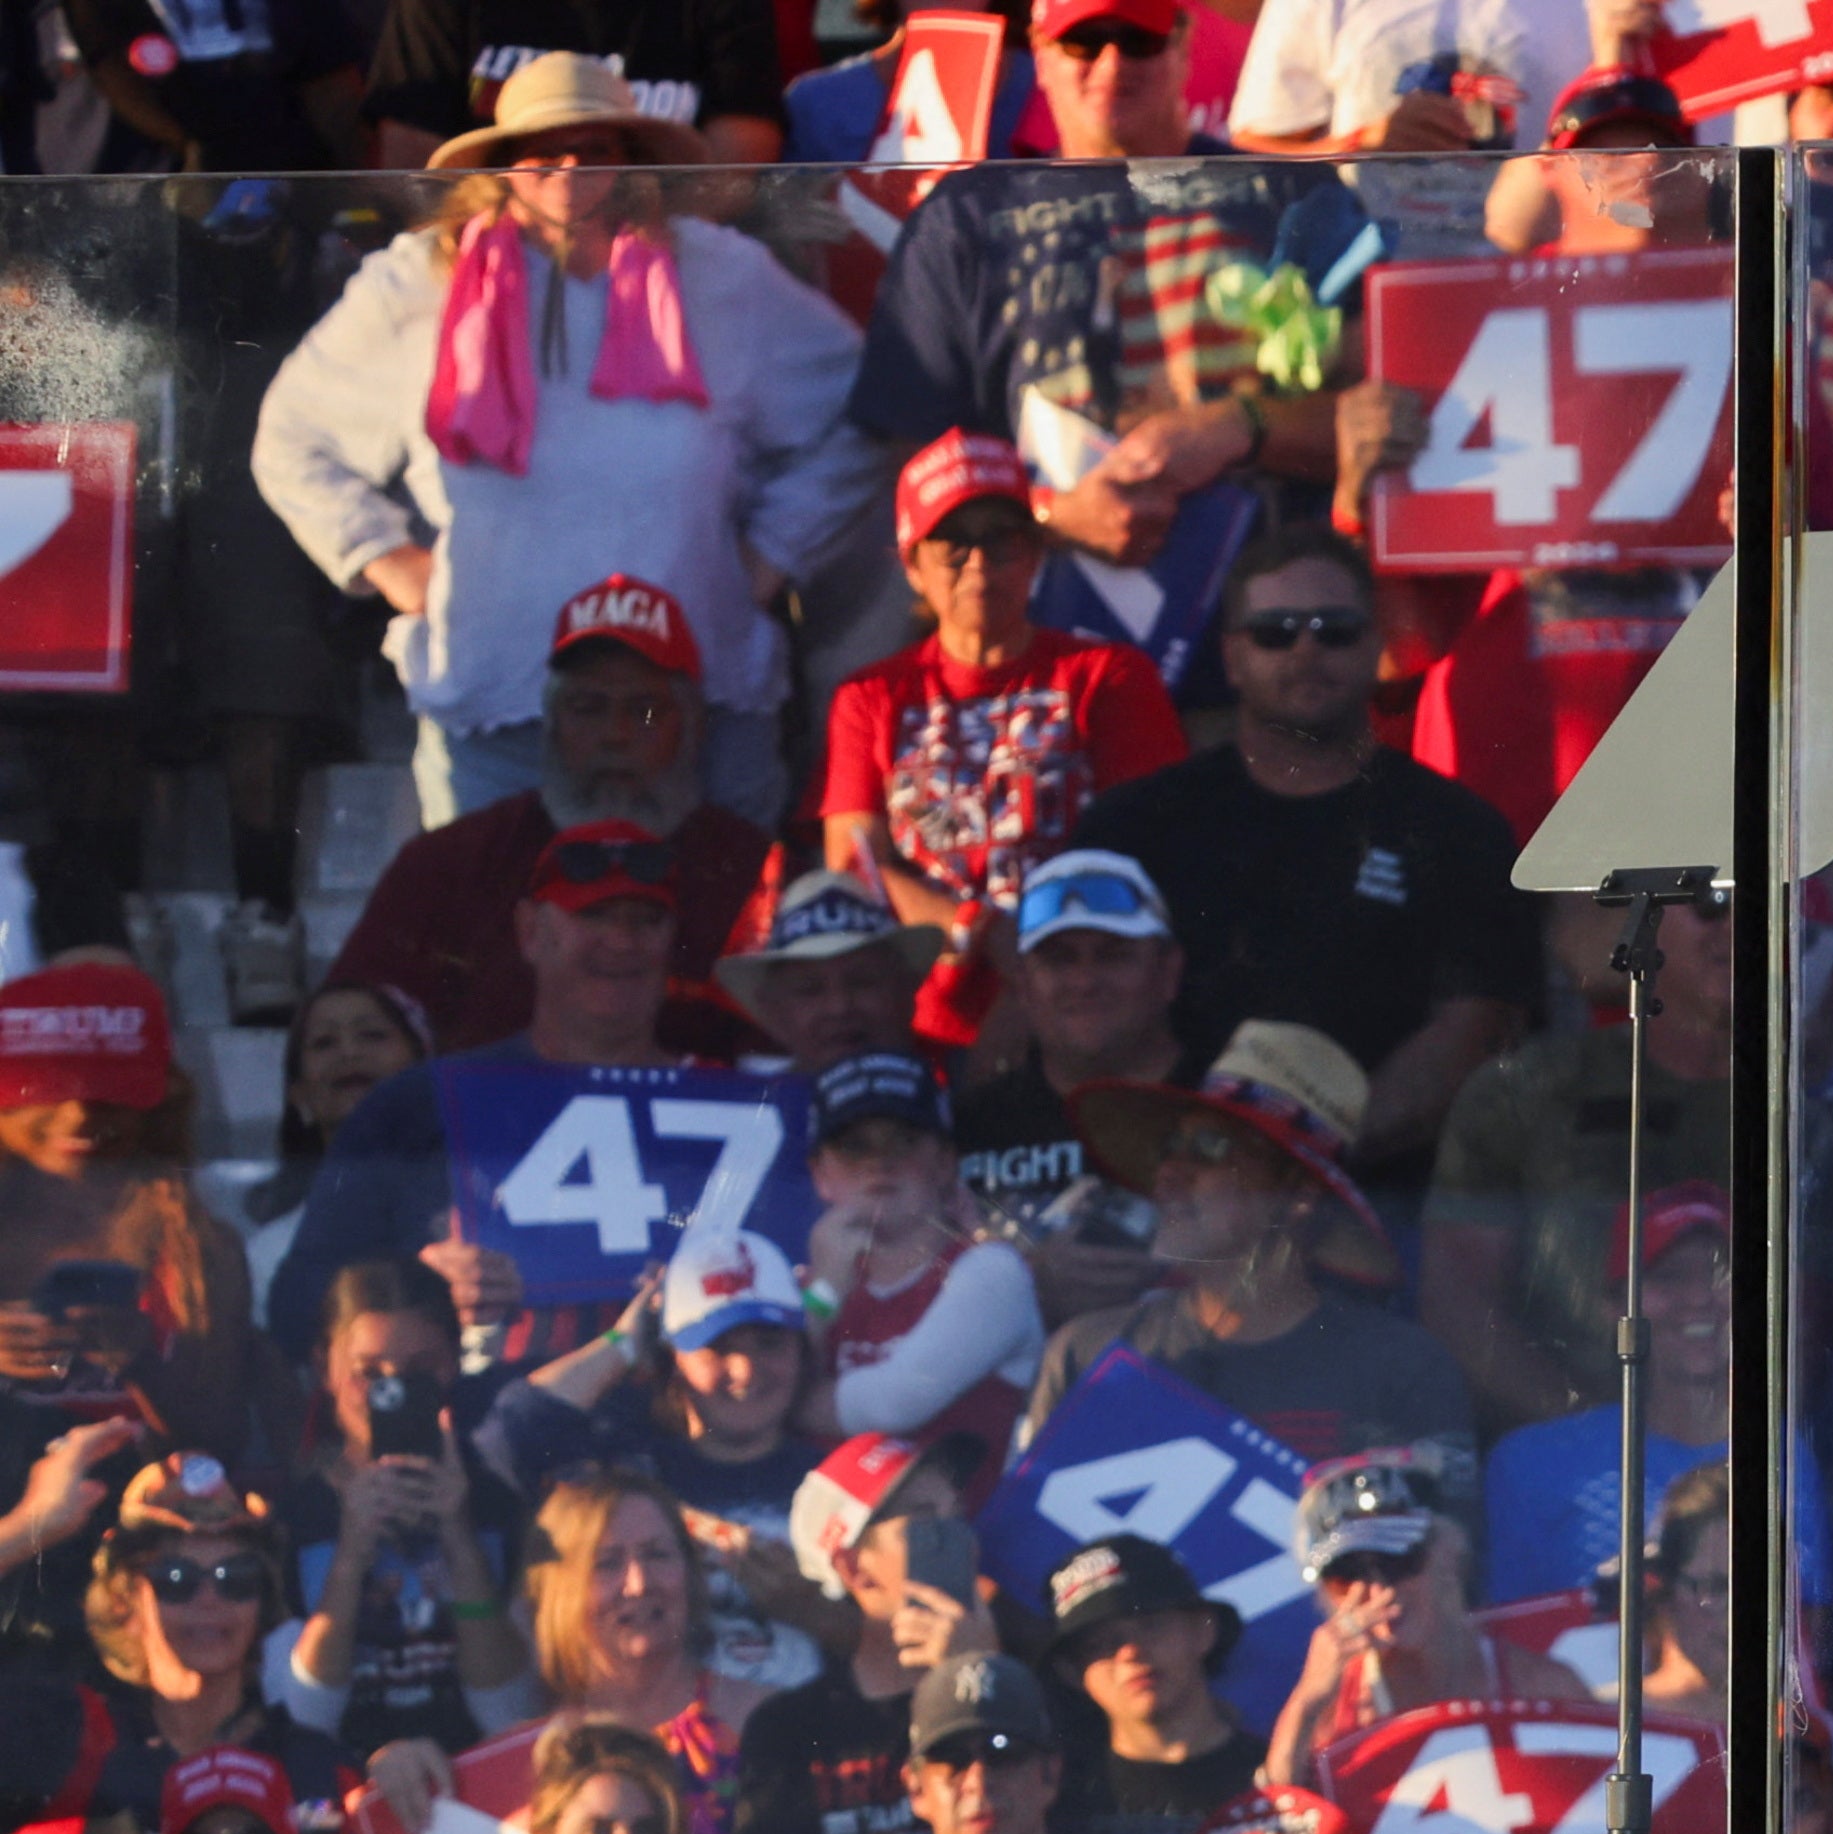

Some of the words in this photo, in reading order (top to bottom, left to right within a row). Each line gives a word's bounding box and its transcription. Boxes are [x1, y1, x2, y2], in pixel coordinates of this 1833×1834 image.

[1407, 298, 1736, 527] 47
[499, 1093, 785, 1257] 47
[957, 1140, 1085, 1191] FIGHT
[1037, 1435, 1302, 1626] 47
